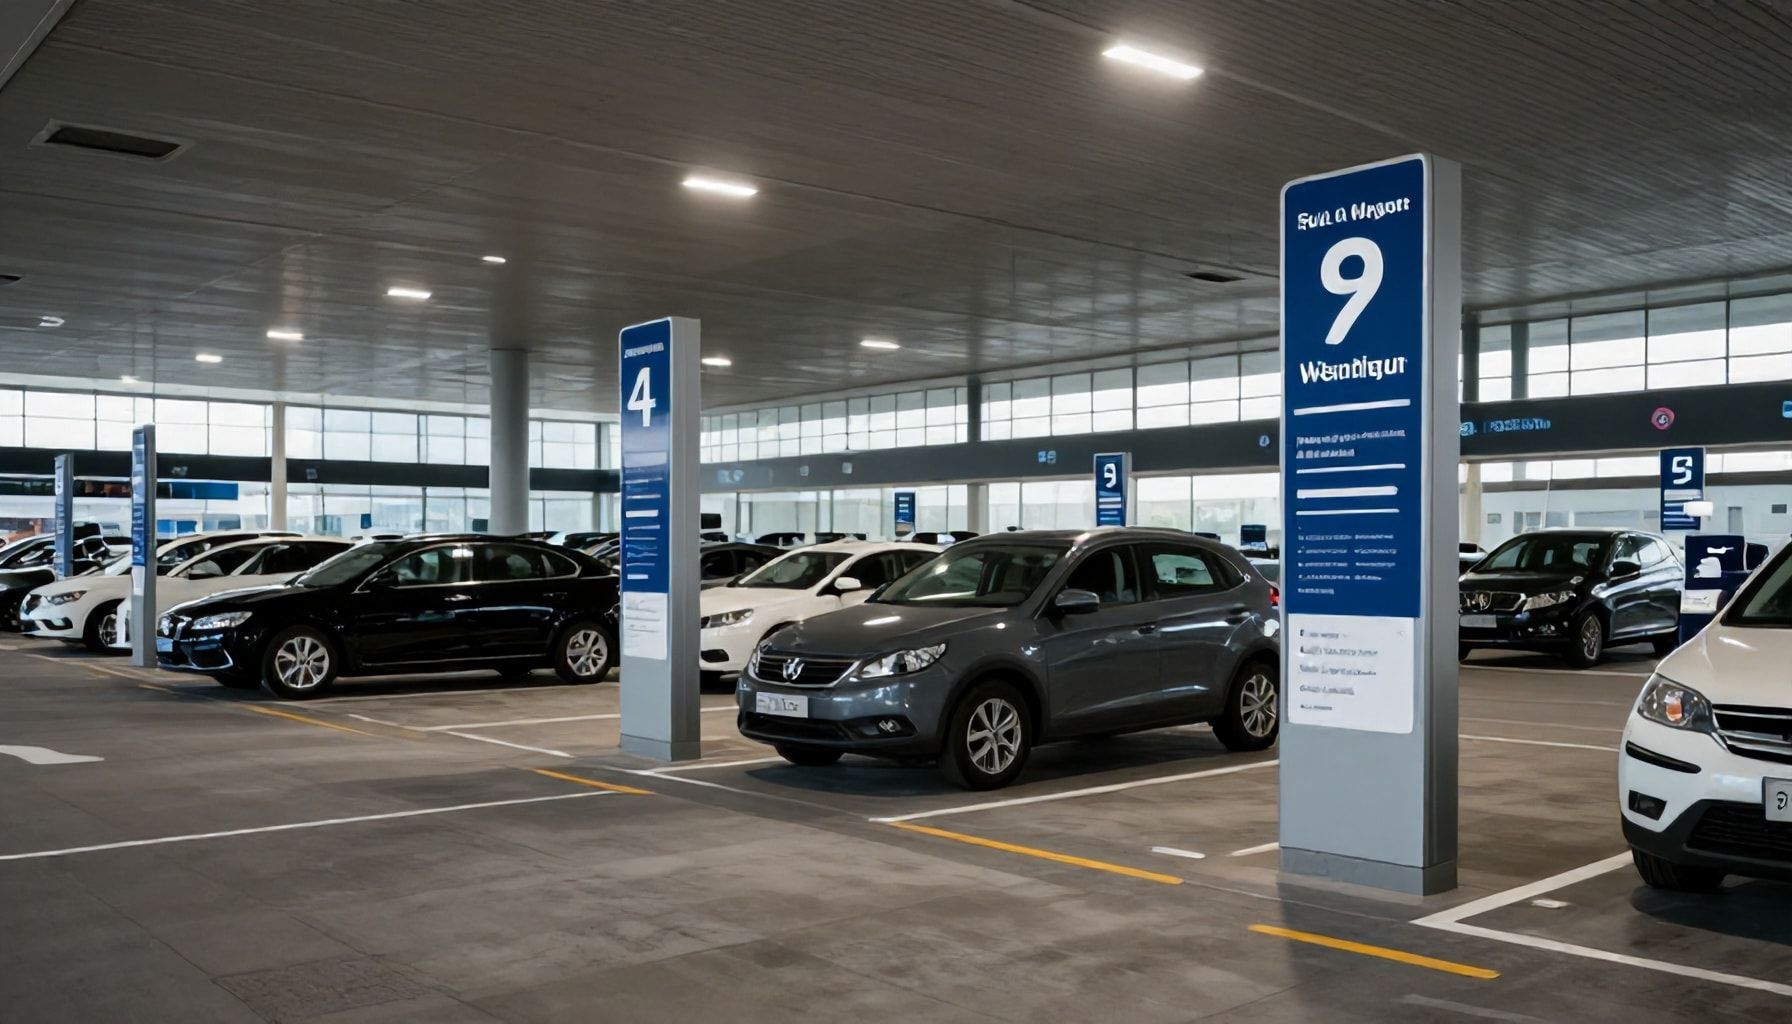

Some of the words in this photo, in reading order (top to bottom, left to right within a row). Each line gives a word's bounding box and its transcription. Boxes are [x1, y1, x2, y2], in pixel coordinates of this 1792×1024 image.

[1320, 236, 1384, 345] 9
[627, 366, 657, 428] 4
[1103, 463, 1117, 488] 9
